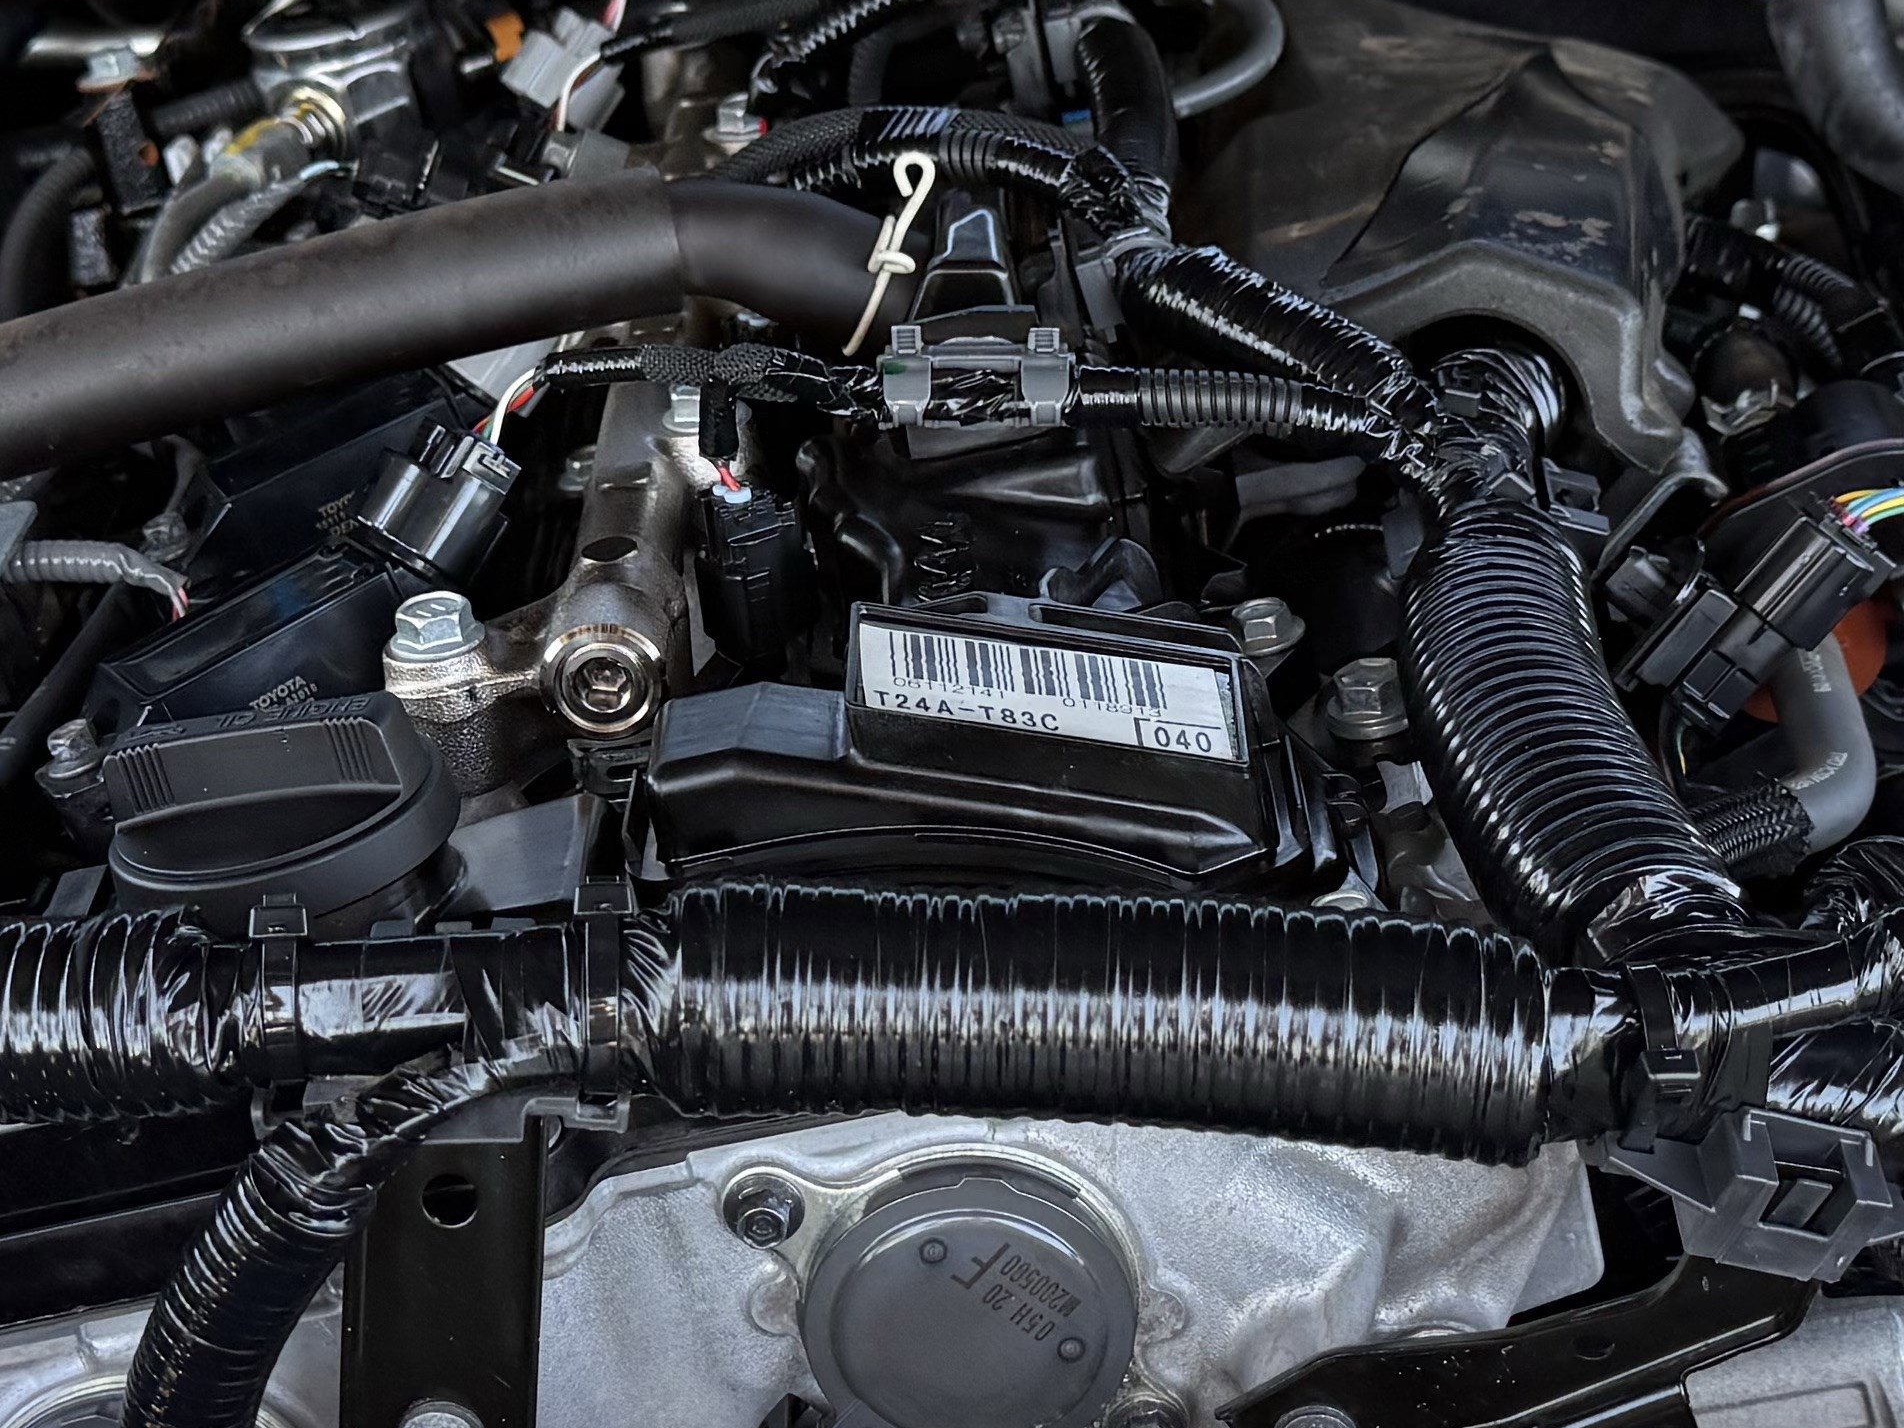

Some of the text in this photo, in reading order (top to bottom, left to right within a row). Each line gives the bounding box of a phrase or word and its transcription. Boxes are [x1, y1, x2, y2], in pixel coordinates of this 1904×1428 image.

[249, 675, 307, 711] TOYOTA
[873, 689, 1060, 732] T24A-T83C
[1153, 725, 1213, 754] 040
